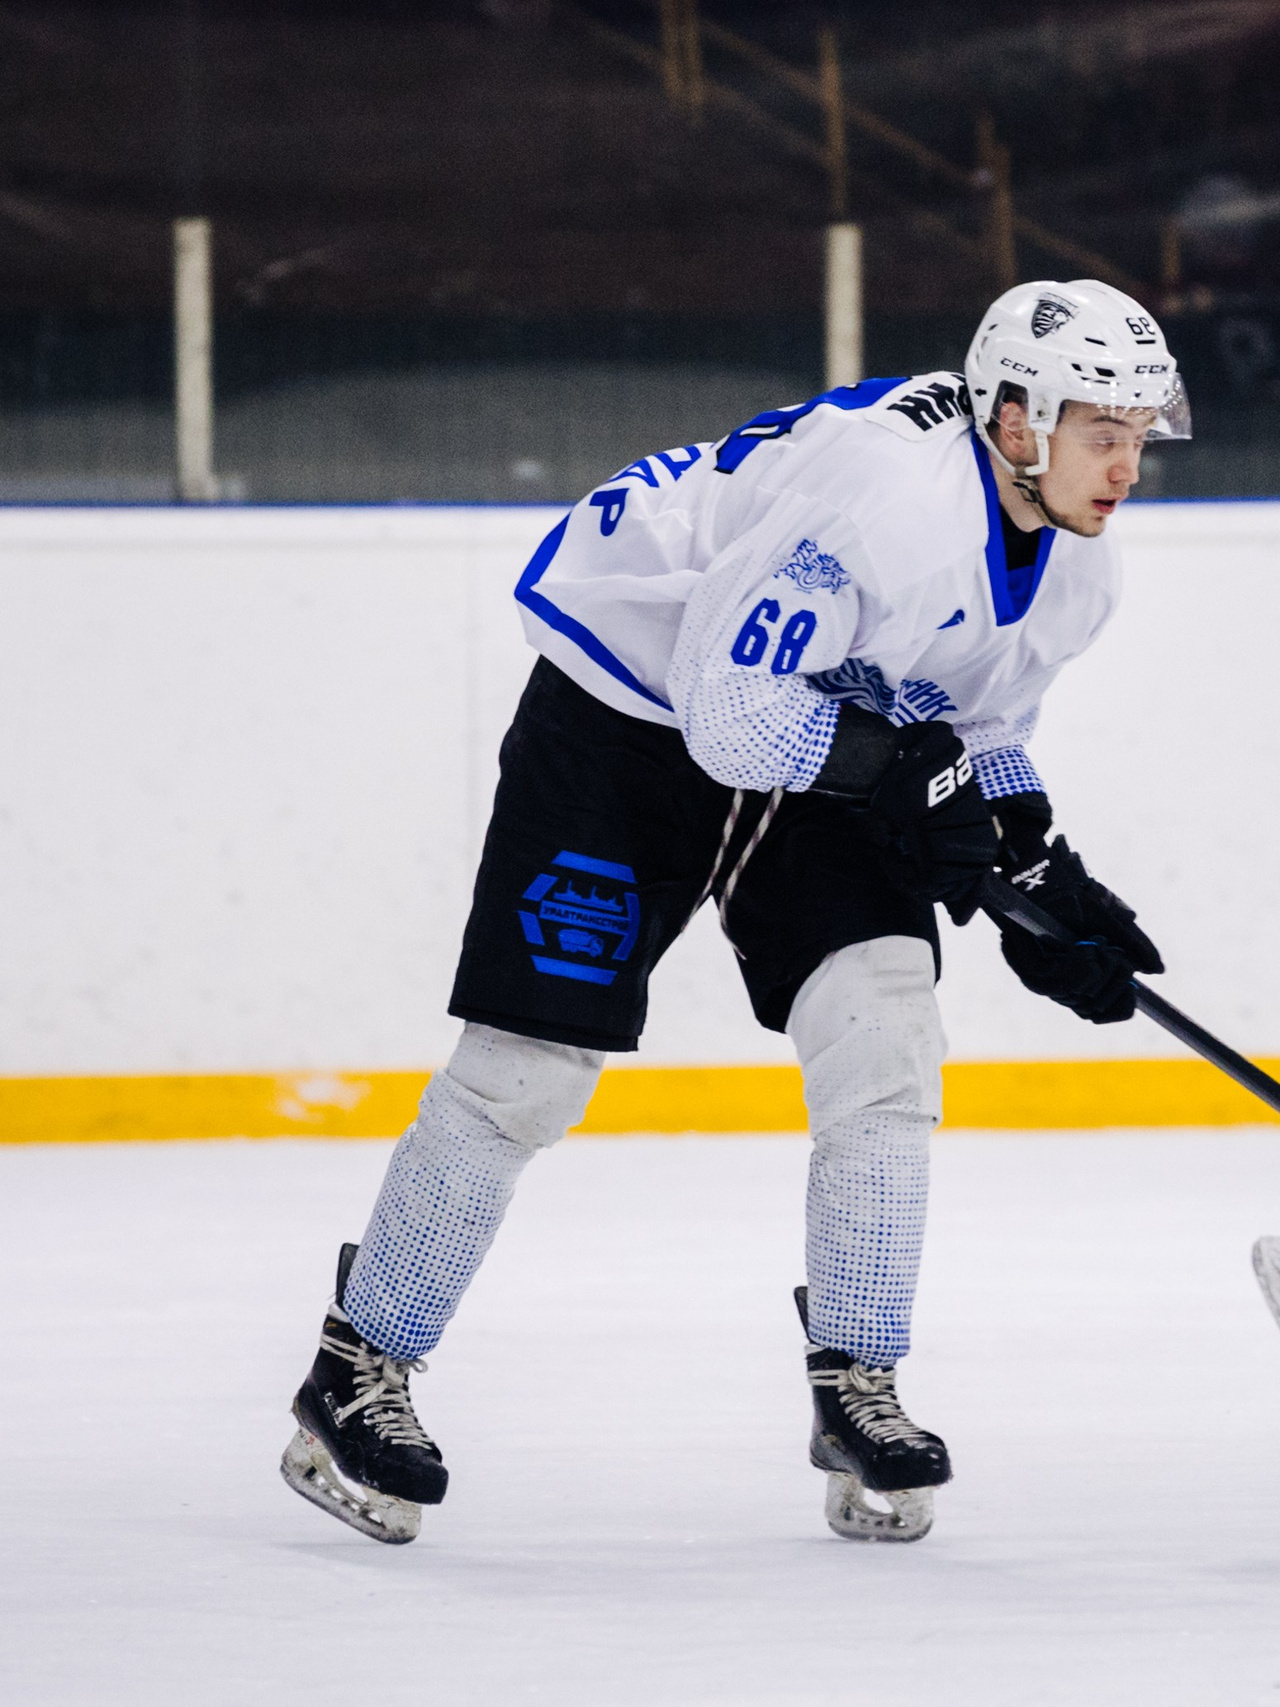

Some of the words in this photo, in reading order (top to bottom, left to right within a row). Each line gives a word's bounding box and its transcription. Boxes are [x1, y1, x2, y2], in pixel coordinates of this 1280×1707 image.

[1125, 317, 1156, 336] 68
[1000, 357, 1038, 377] CCM
[731, 598, 817, 675] 68
